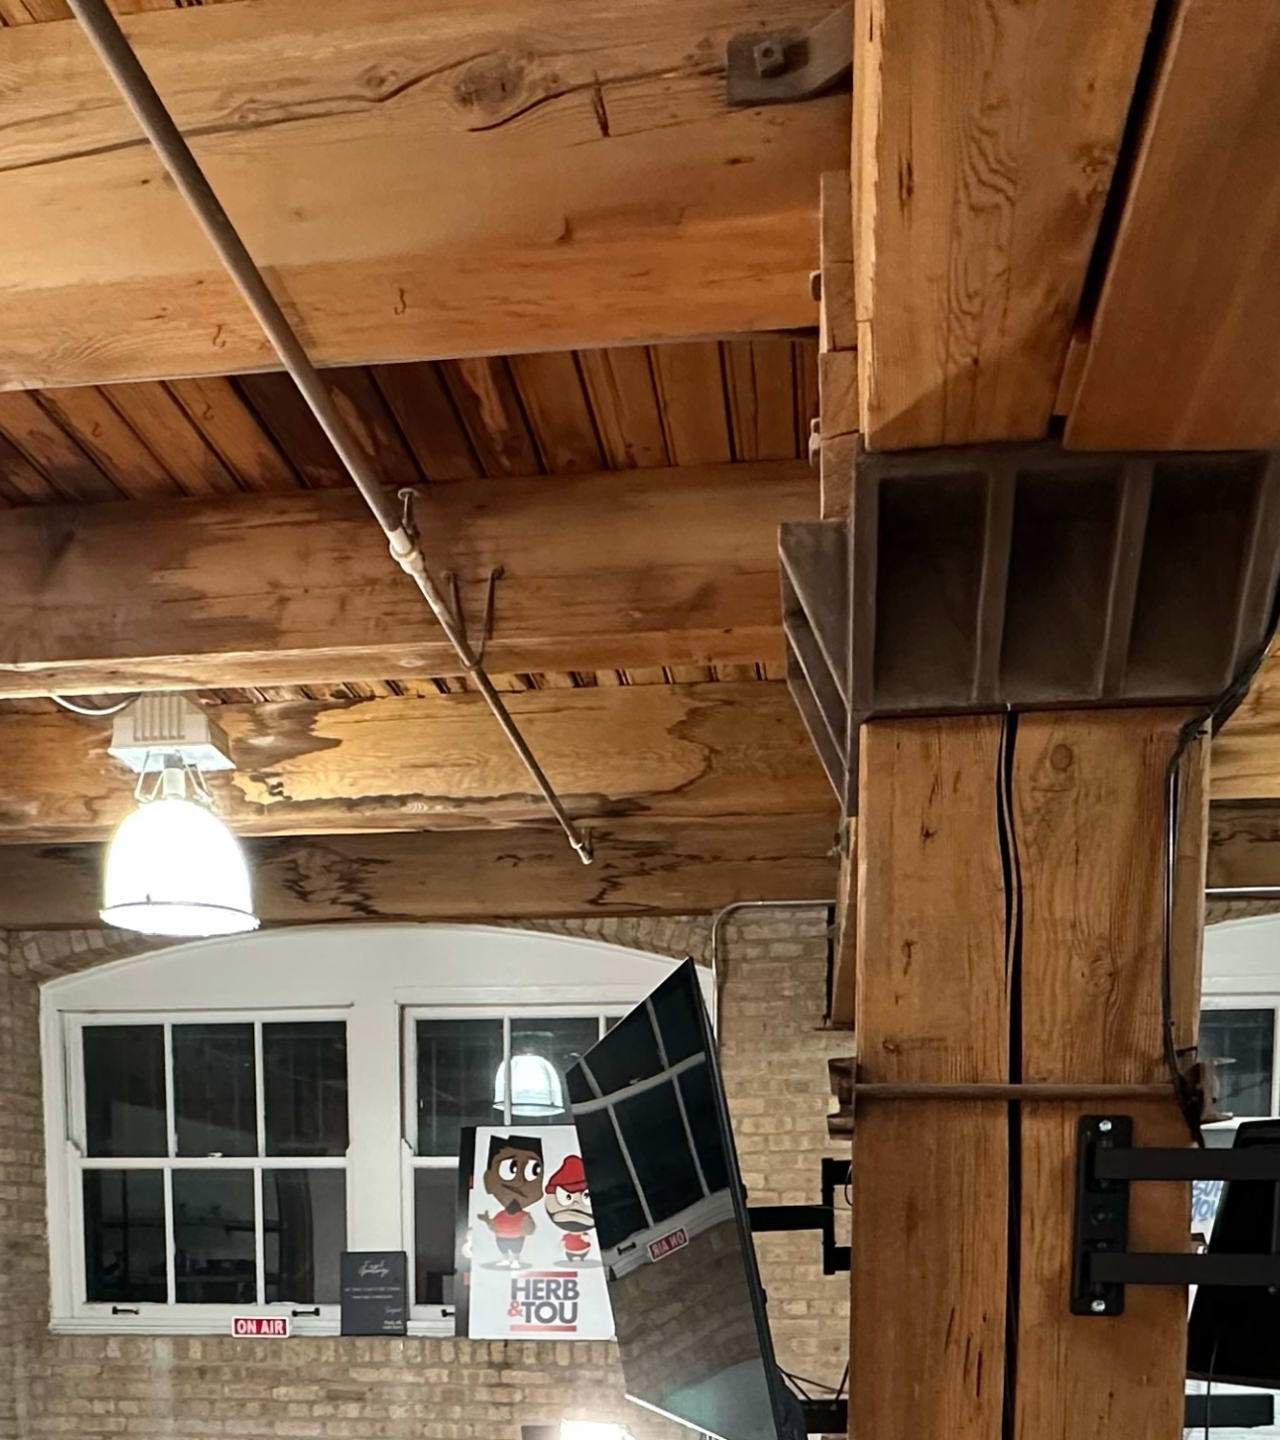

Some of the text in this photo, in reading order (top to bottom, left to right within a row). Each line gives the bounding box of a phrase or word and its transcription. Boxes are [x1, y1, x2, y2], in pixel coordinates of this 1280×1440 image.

[511, 1279, 580, 1301] HERB
[236, 1319, 284, 1335] ON AIR
